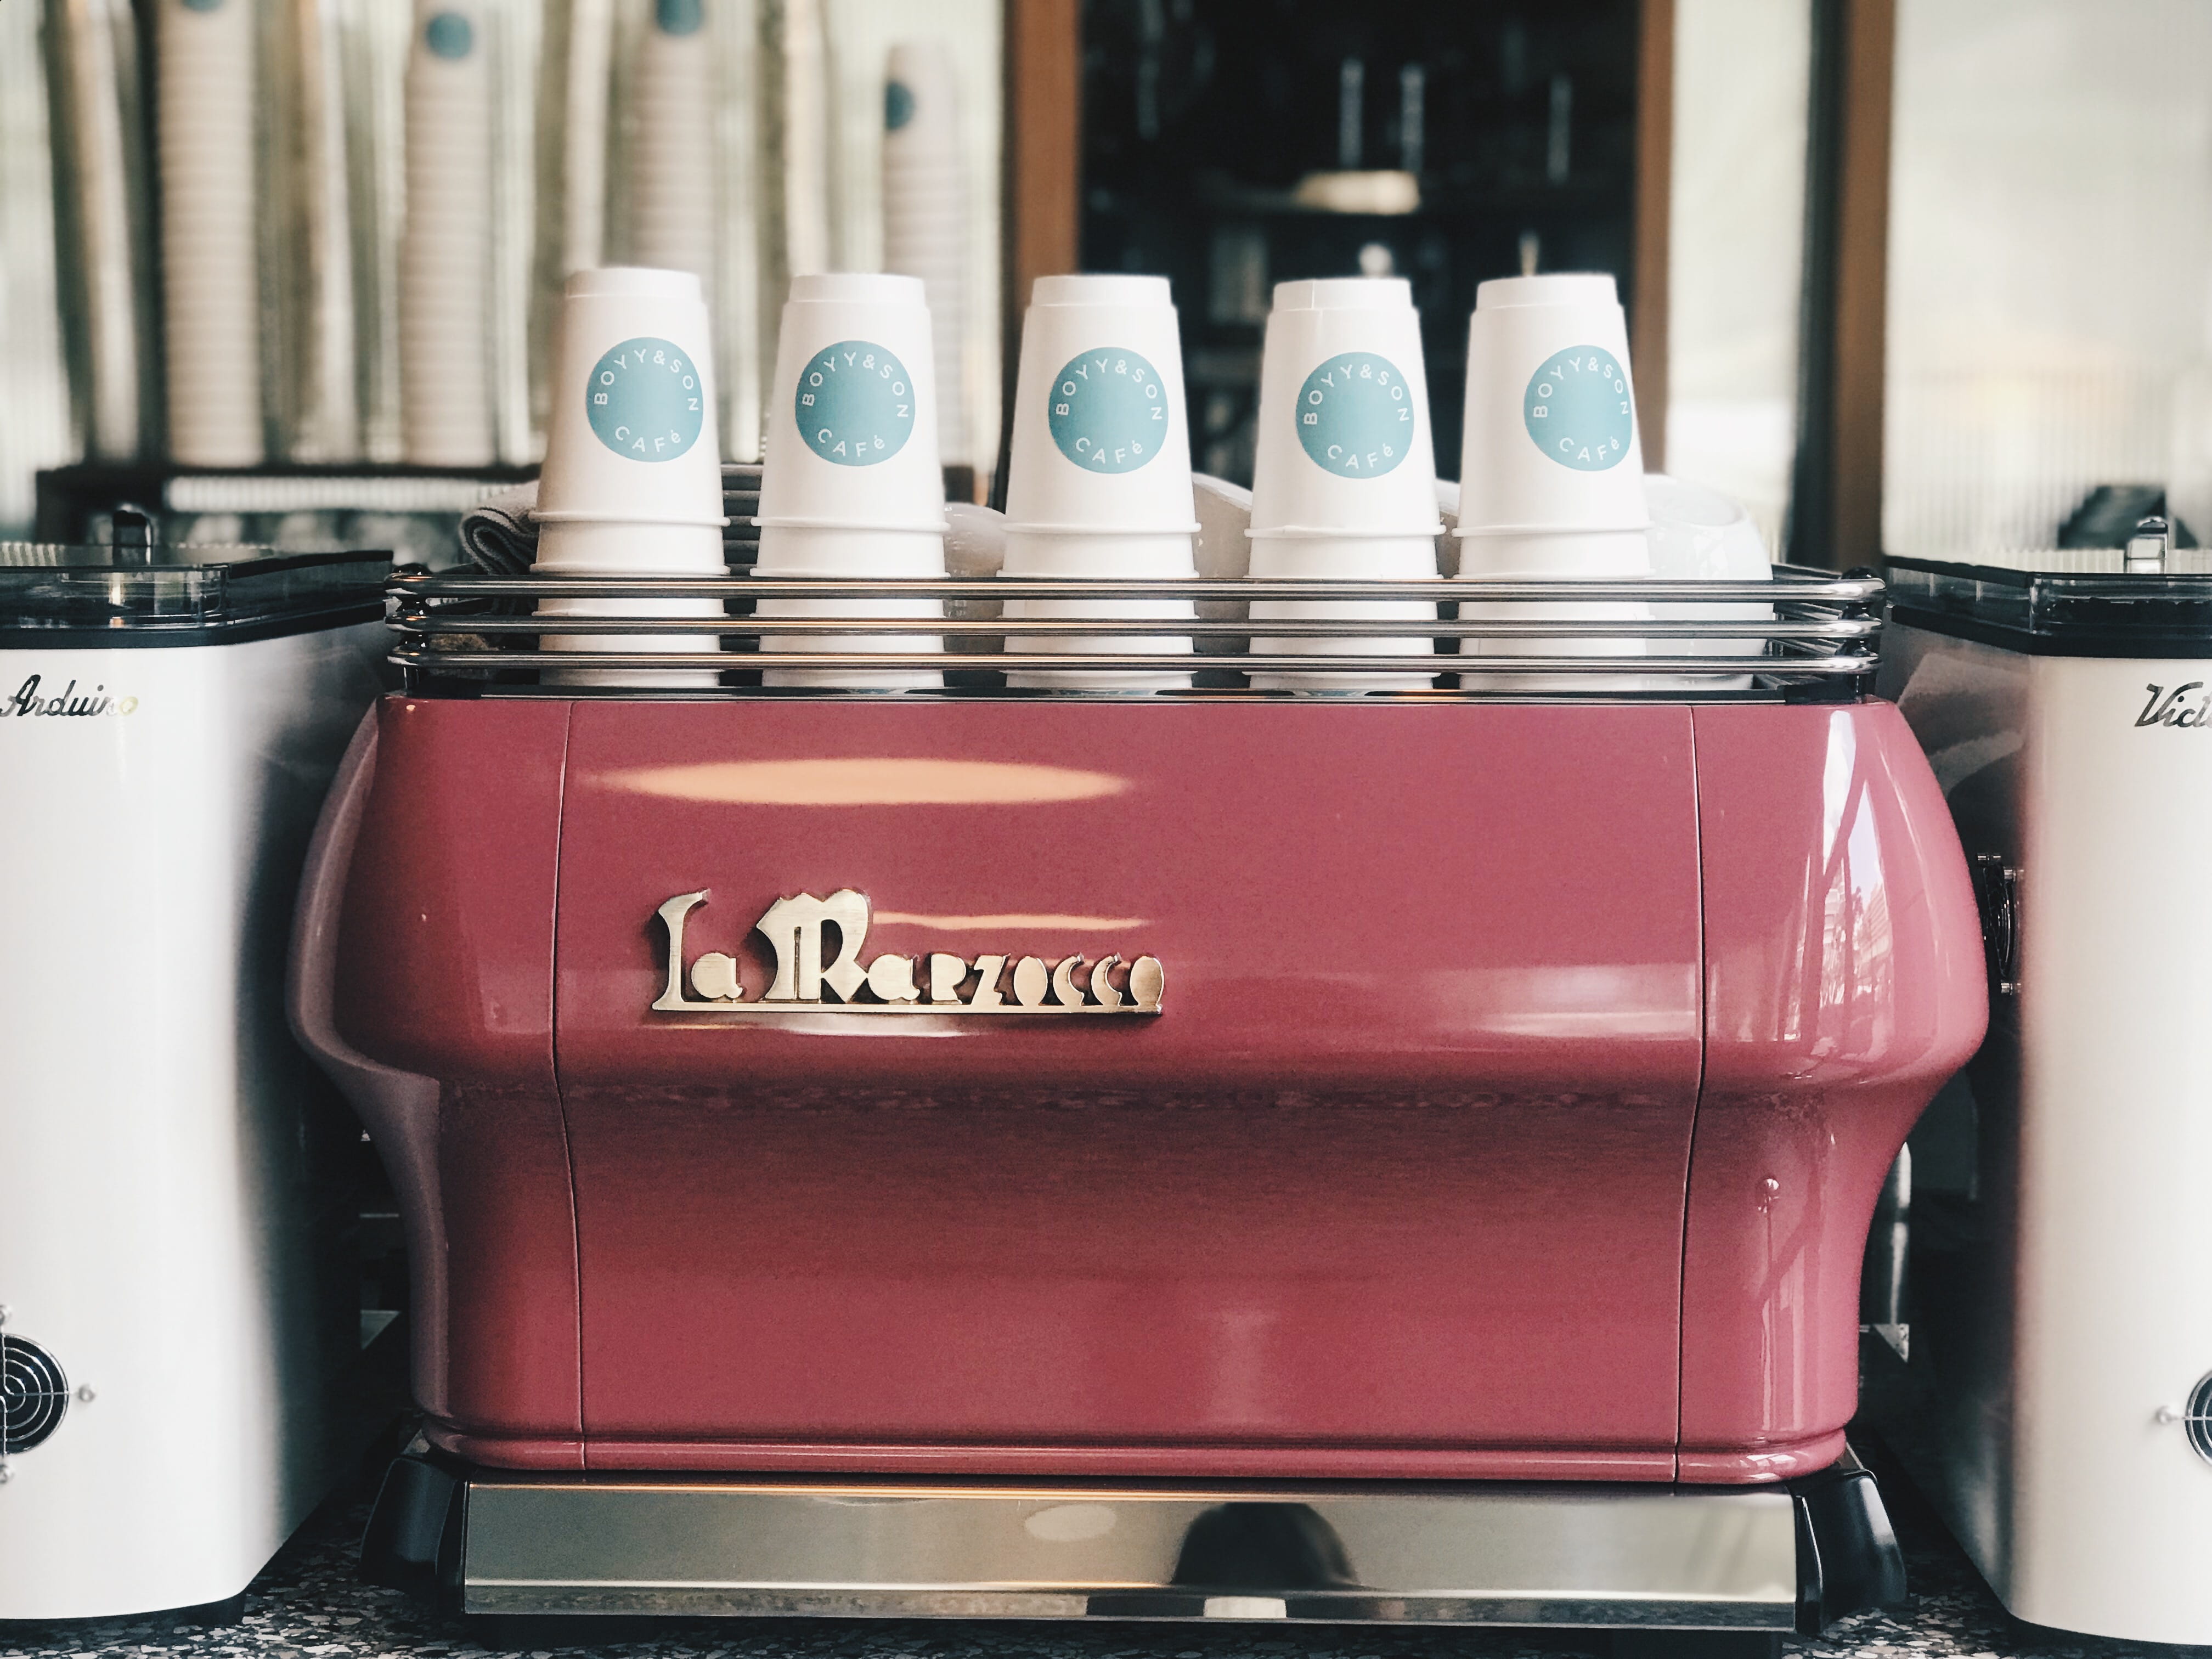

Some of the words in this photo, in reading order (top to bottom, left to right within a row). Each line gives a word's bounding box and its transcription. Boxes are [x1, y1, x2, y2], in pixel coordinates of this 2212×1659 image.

[594, 348, 699, 411] BOYY&SON
[802, 352, 909, 419] BOYY&SON
[1055, 359, 1164, 421] BOYY&SON
[1303, 364, 1409, 425] BOYY&SON
[1533, 355, 1629, 418] BOYY&SON
[0, 674, 139, 716] Arduino
[653, 888, 743, 1011] La
[757, 888, 1164, 1011] Marzocco
